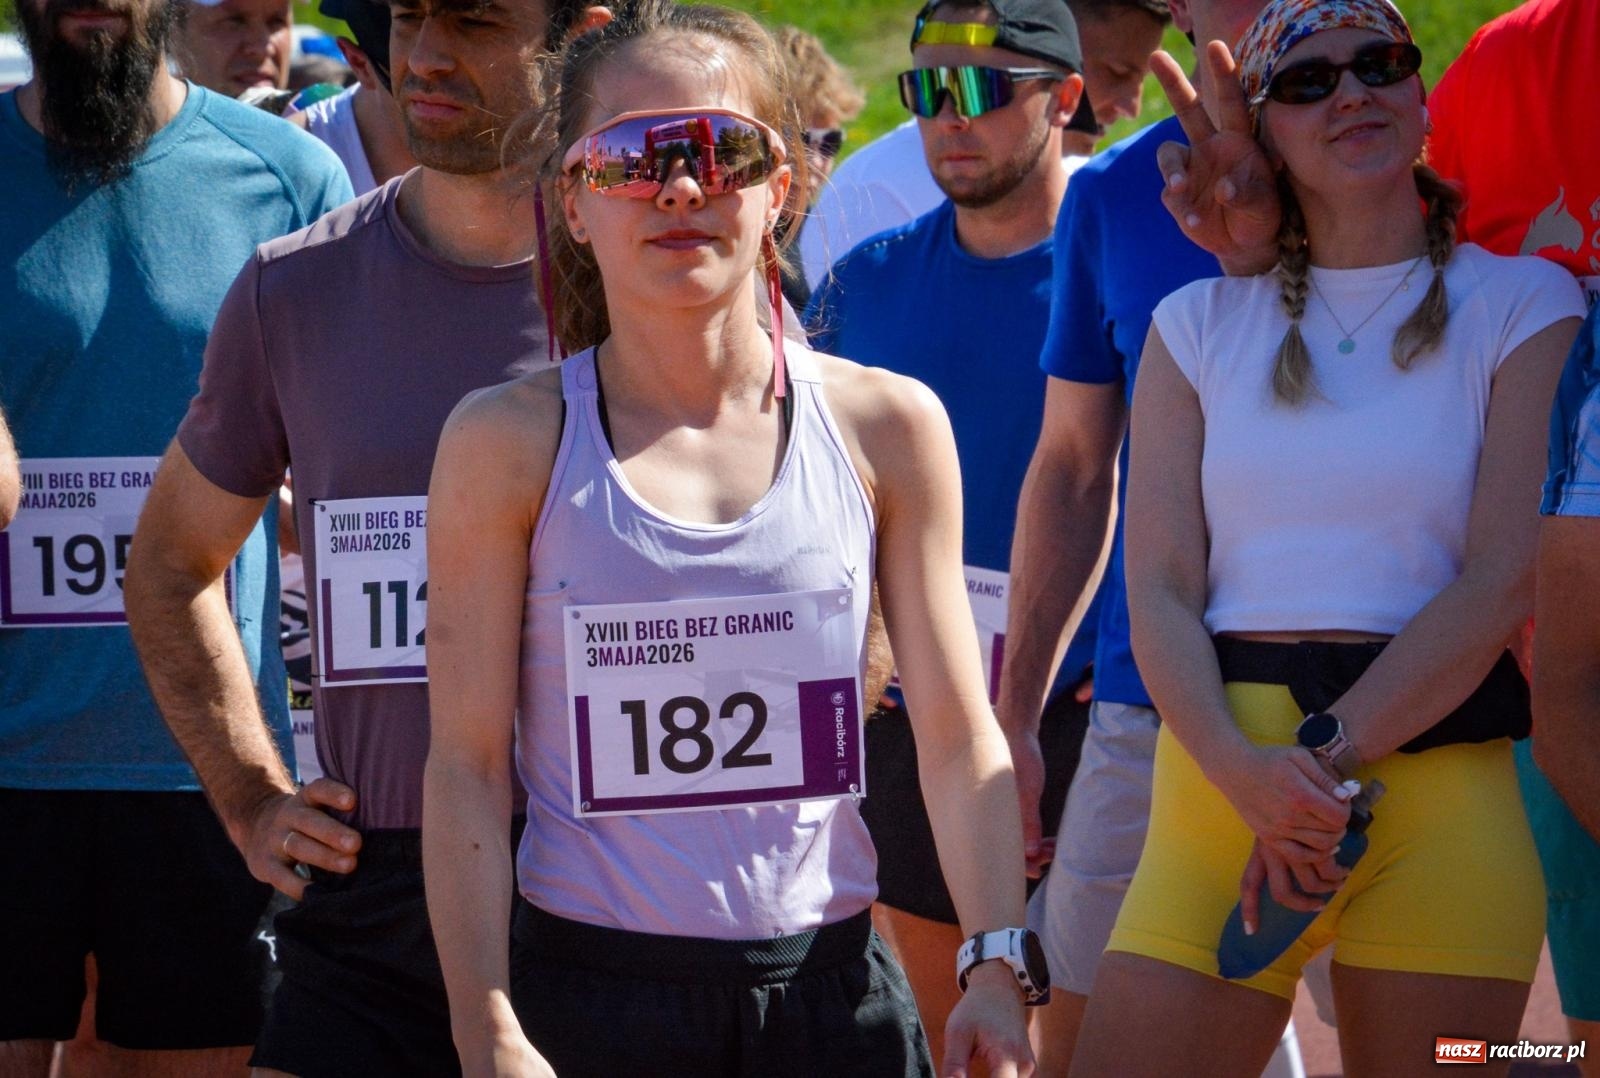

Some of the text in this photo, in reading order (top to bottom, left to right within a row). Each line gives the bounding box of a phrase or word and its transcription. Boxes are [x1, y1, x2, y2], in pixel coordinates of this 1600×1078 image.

[49, 473, 83, 489] BIEG
[89, 472, 116, 488] BEZ
[121, 472, 155, 488] GRA
[20, 492, 96, 509] MAJA2026
[329, 513, 361, 532] XVIII
[365, 510, 399, 530] BIEG
[330, 532, 411, 554] 3MAJA2026
[965, 579, 1004, 599] RANIC
[585, 610, 795, 643] XVIII BIEG BEZ GRANIC
[586, 642, 695, 667] 3MAJA2026
[620, 691, 773, 775] 182
[835, 707, 847, 758] Racibórz
